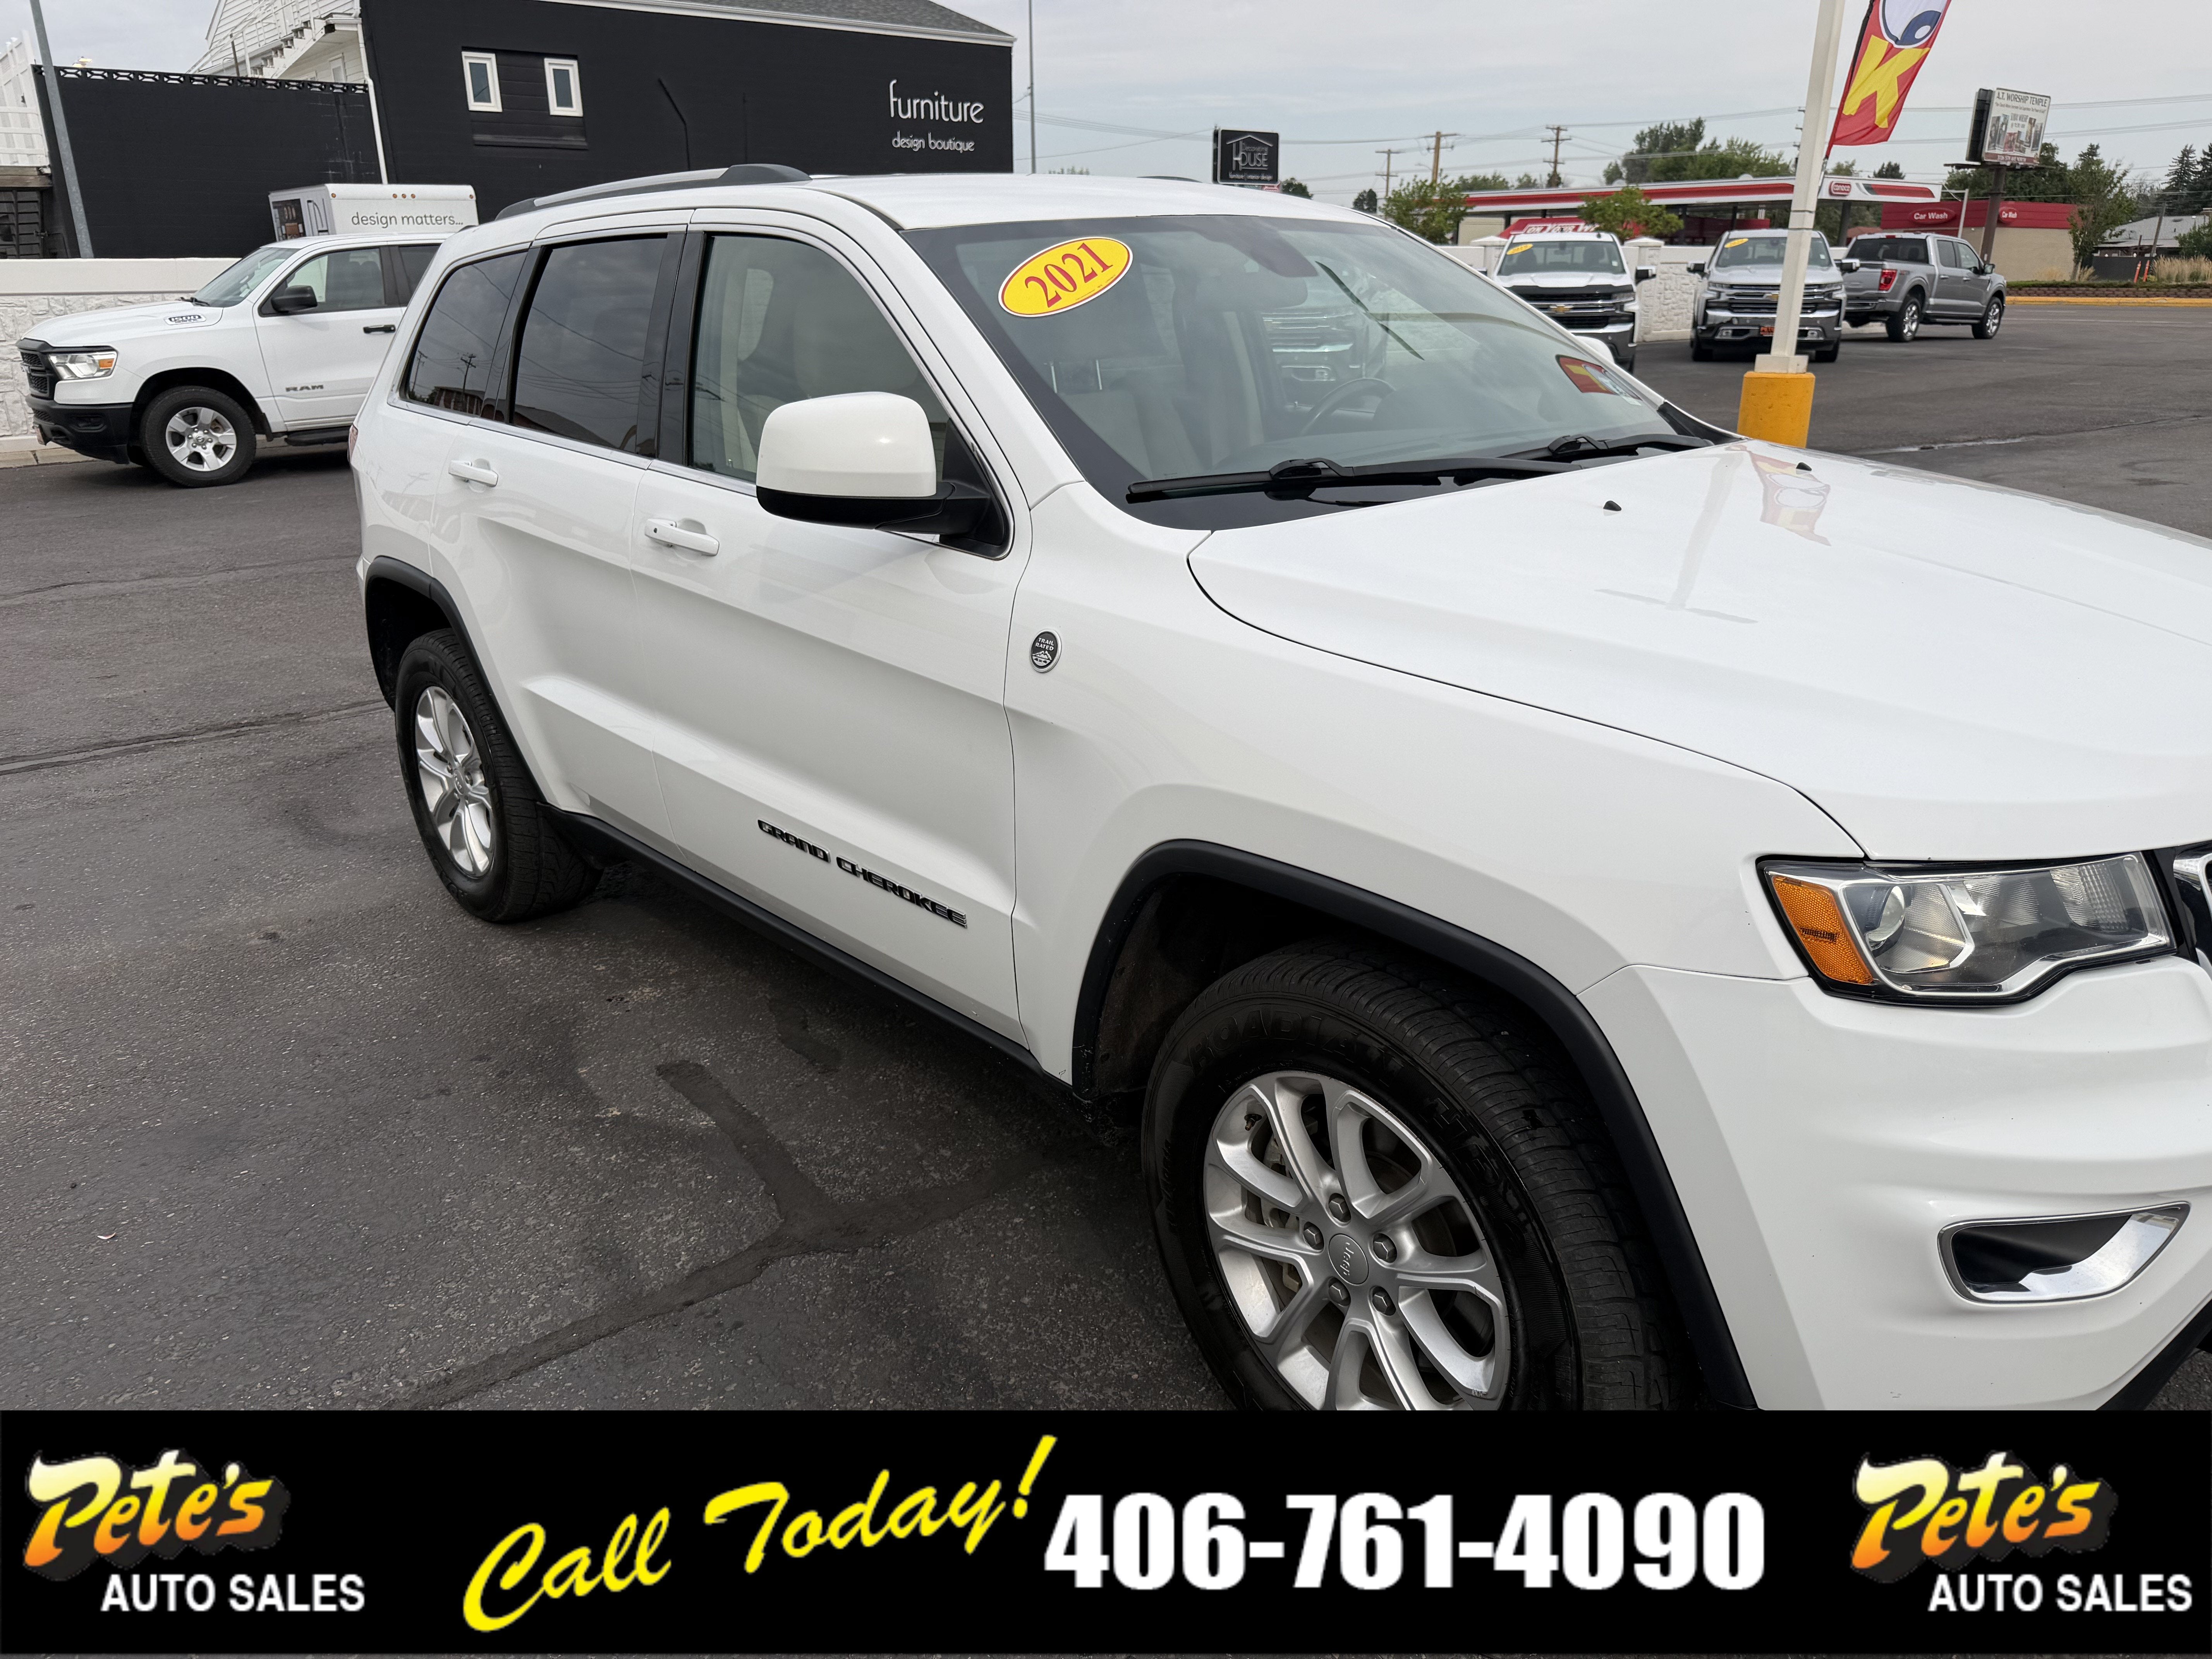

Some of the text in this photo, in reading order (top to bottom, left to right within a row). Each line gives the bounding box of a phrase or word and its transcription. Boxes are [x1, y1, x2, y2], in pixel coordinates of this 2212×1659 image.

[889, 79, 984, 123] furniture
[2007, 93, 2029, 104] WORSHIP
[2030, 96, 2048, 107] TEMPLE
[891, 130, 975, 153] design boutique
[351, 212, 464, 228] design matters...
[1024, 242, 1113, 308] 2021
[1036, 642, 1054, 651] RATED
[1039, 638, 1054, 646] TRAIL
[757, 818, 968, 929] GRAND CHEROKEE
[1340, 1242, 1355, 1276] Jeep
